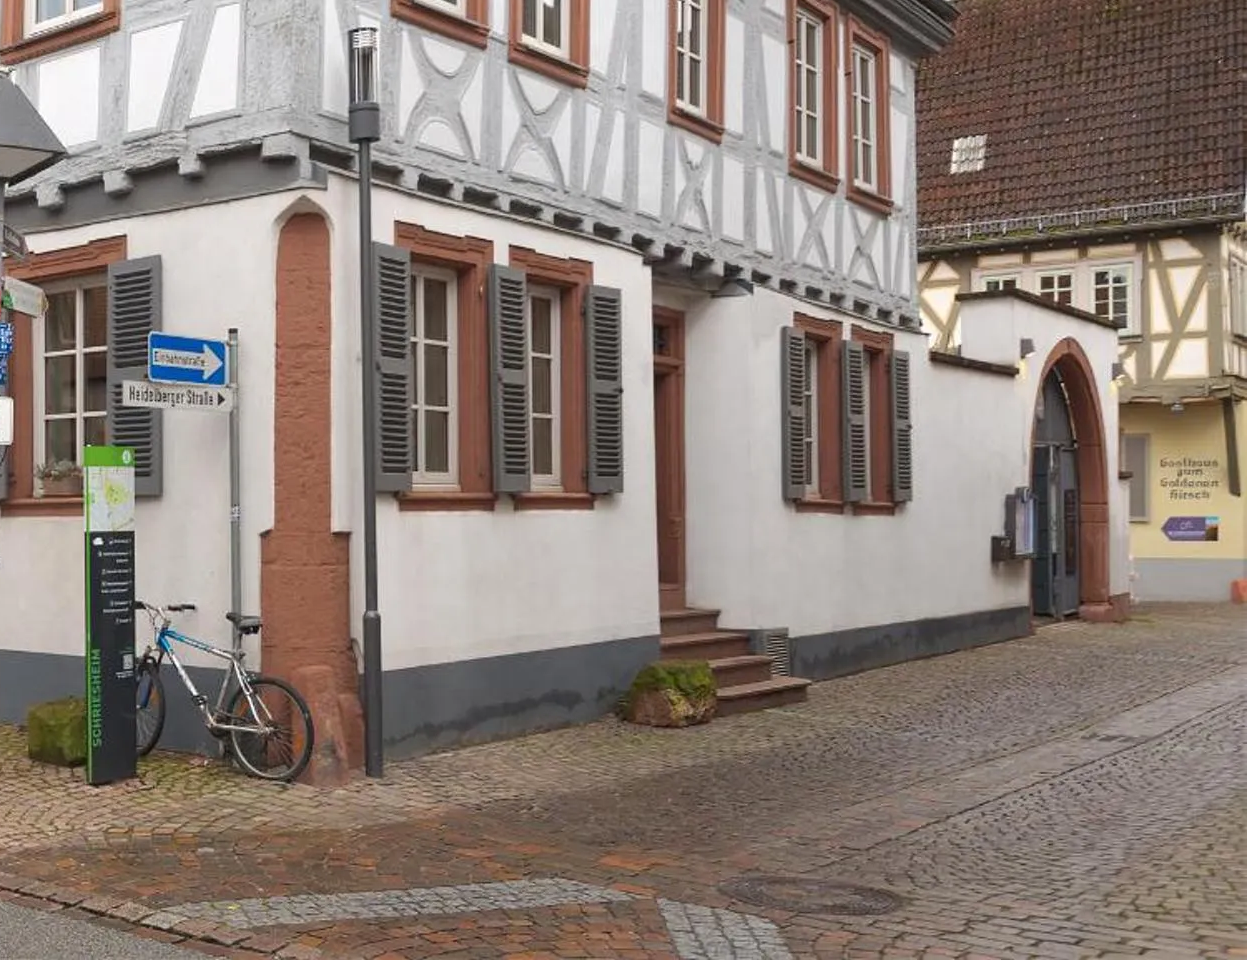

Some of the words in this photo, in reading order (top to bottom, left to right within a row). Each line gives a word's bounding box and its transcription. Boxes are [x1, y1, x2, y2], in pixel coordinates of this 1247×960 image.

[128, 385, 184, 408] Heidelberger
[186, 388, 214, 406] Straße
[91, 647, 103, 748] SCHRIESHEIM
